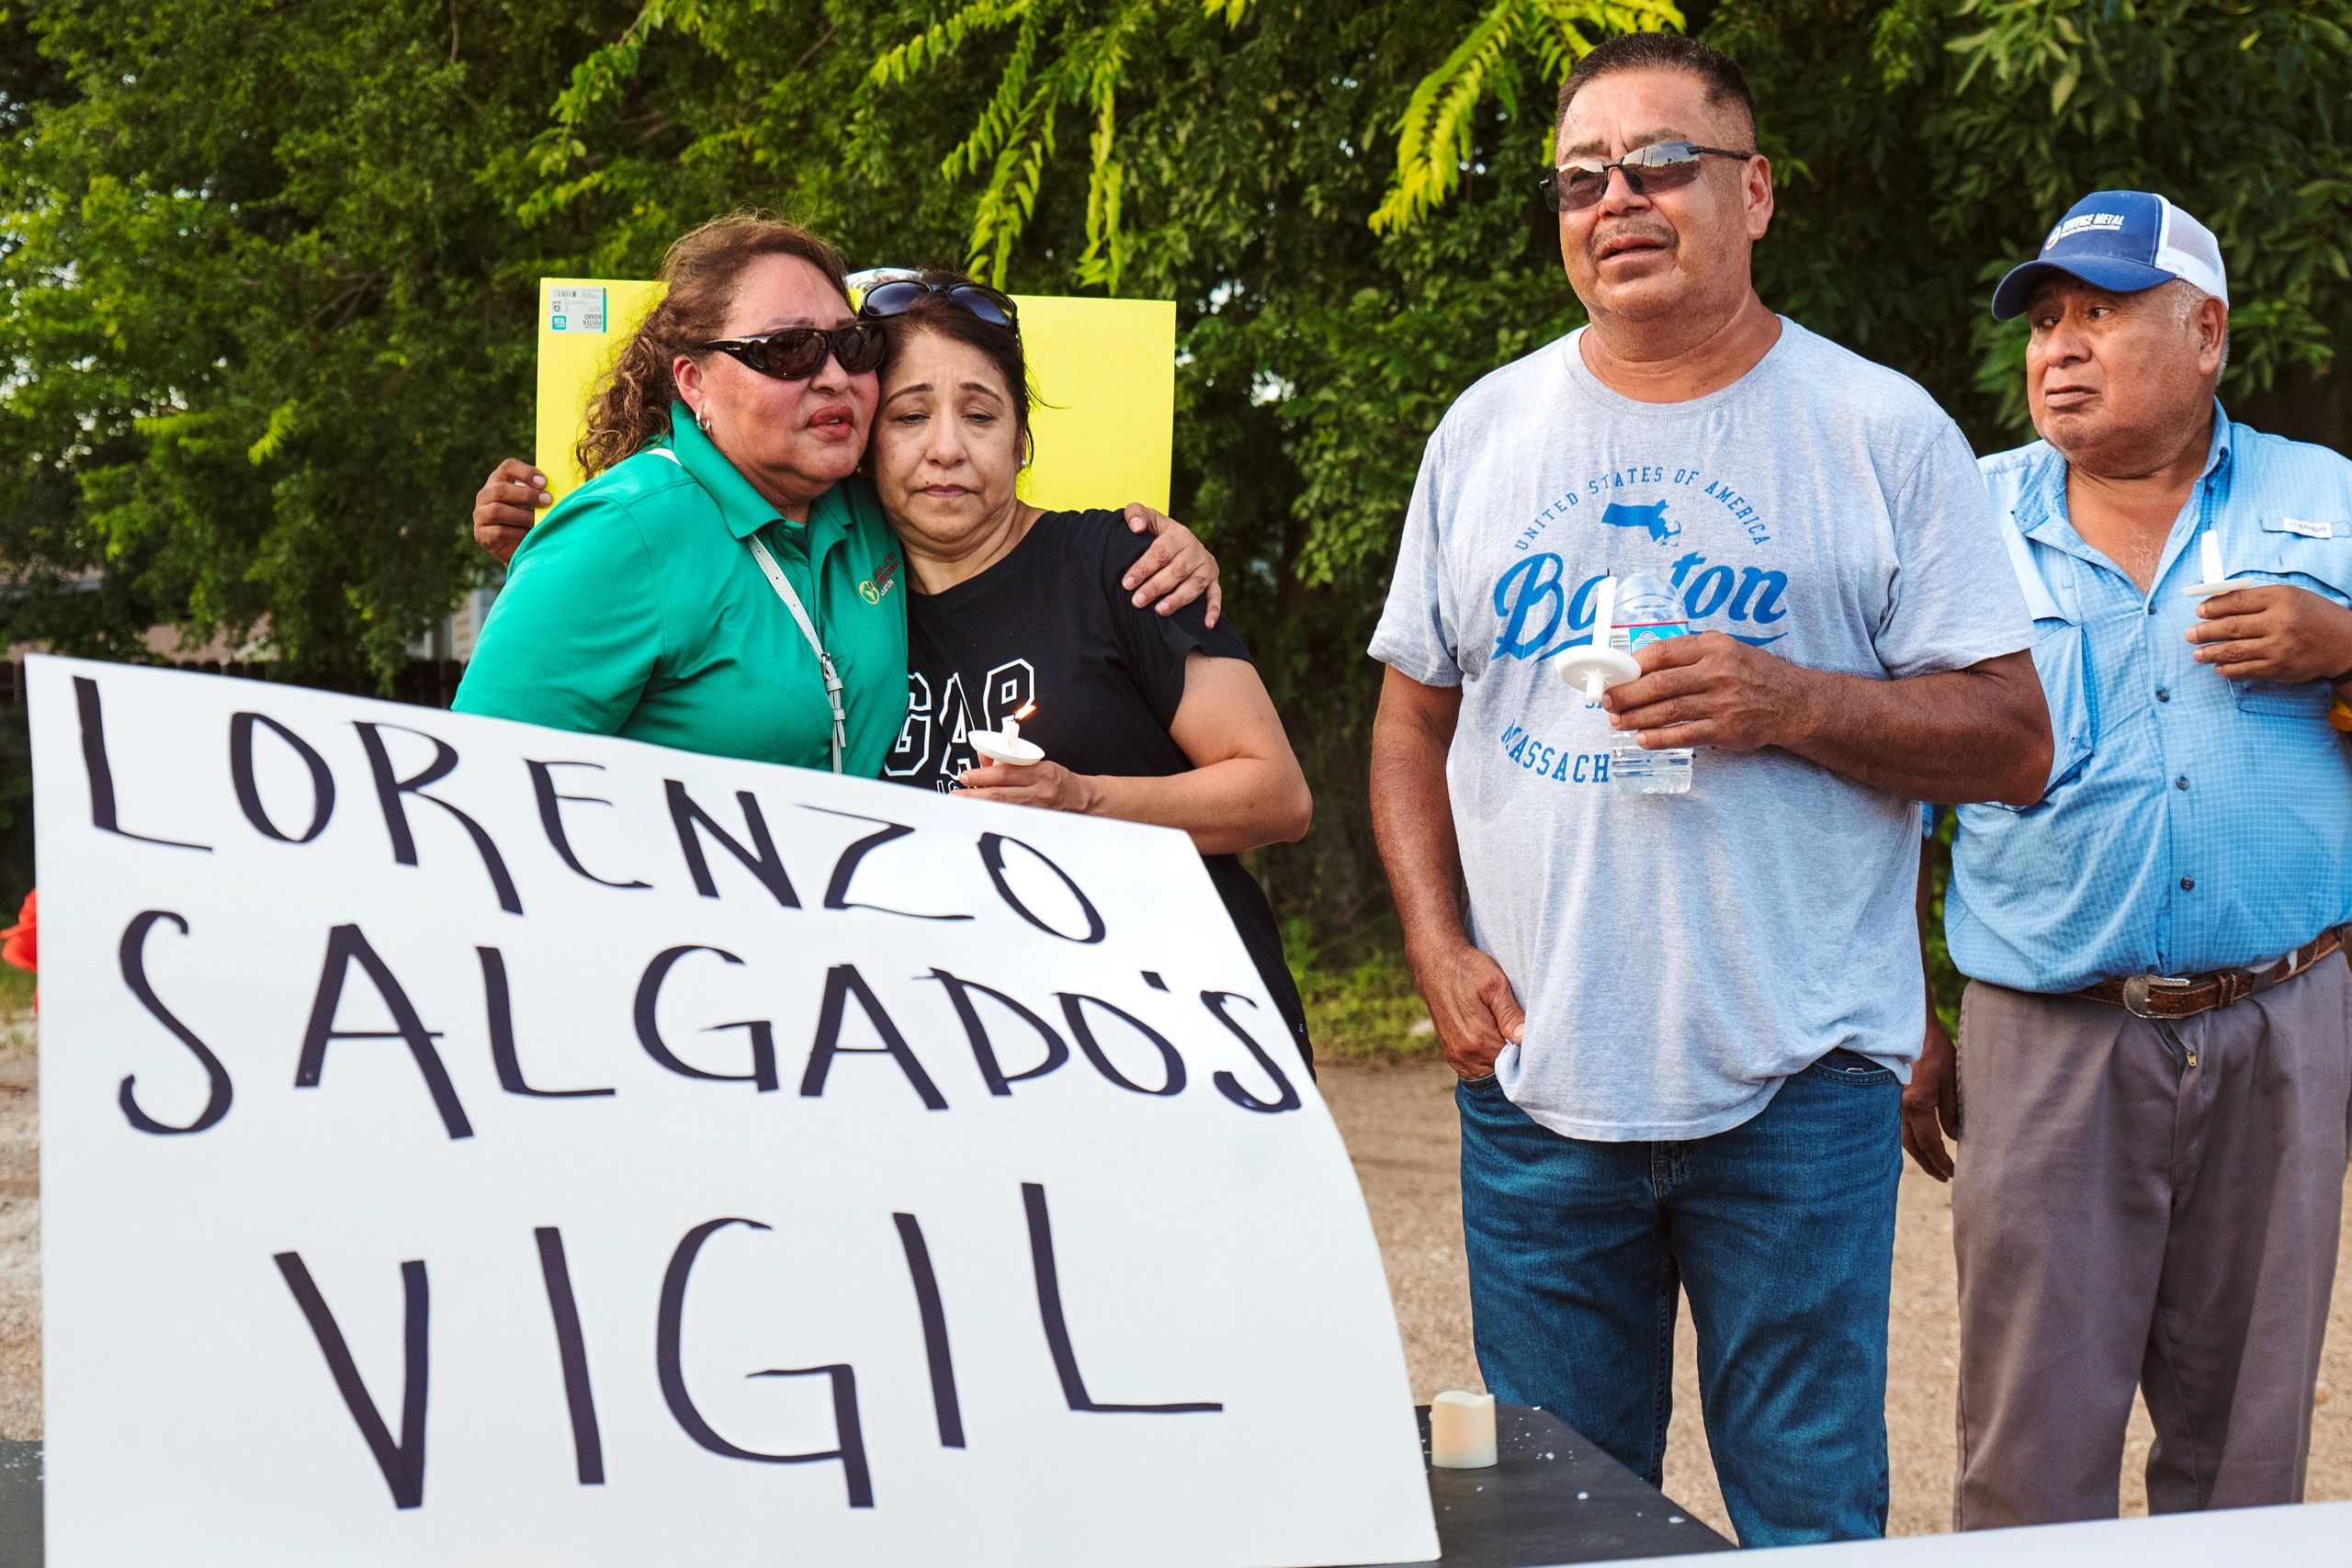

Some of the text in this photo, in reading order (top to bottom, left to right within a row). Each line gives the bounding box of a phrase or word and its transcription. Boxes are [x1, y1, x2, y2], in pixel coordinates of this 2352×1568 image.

[2093, 213, 2125, 226] METAL
[1515, 467, 1771, 551] UNITED STATES OF AMERICA
[1491, 551, 1788, 660] Boton
[884, 658, 1035, 781] GAP
[1500, 718, 1610, 784] MASSACH
[73, 676, 1104, 943] LORENZO
[119, 910, 1302, 1140] SALGADO'S
[274, 1182, 1222, 1509] VIGIL
